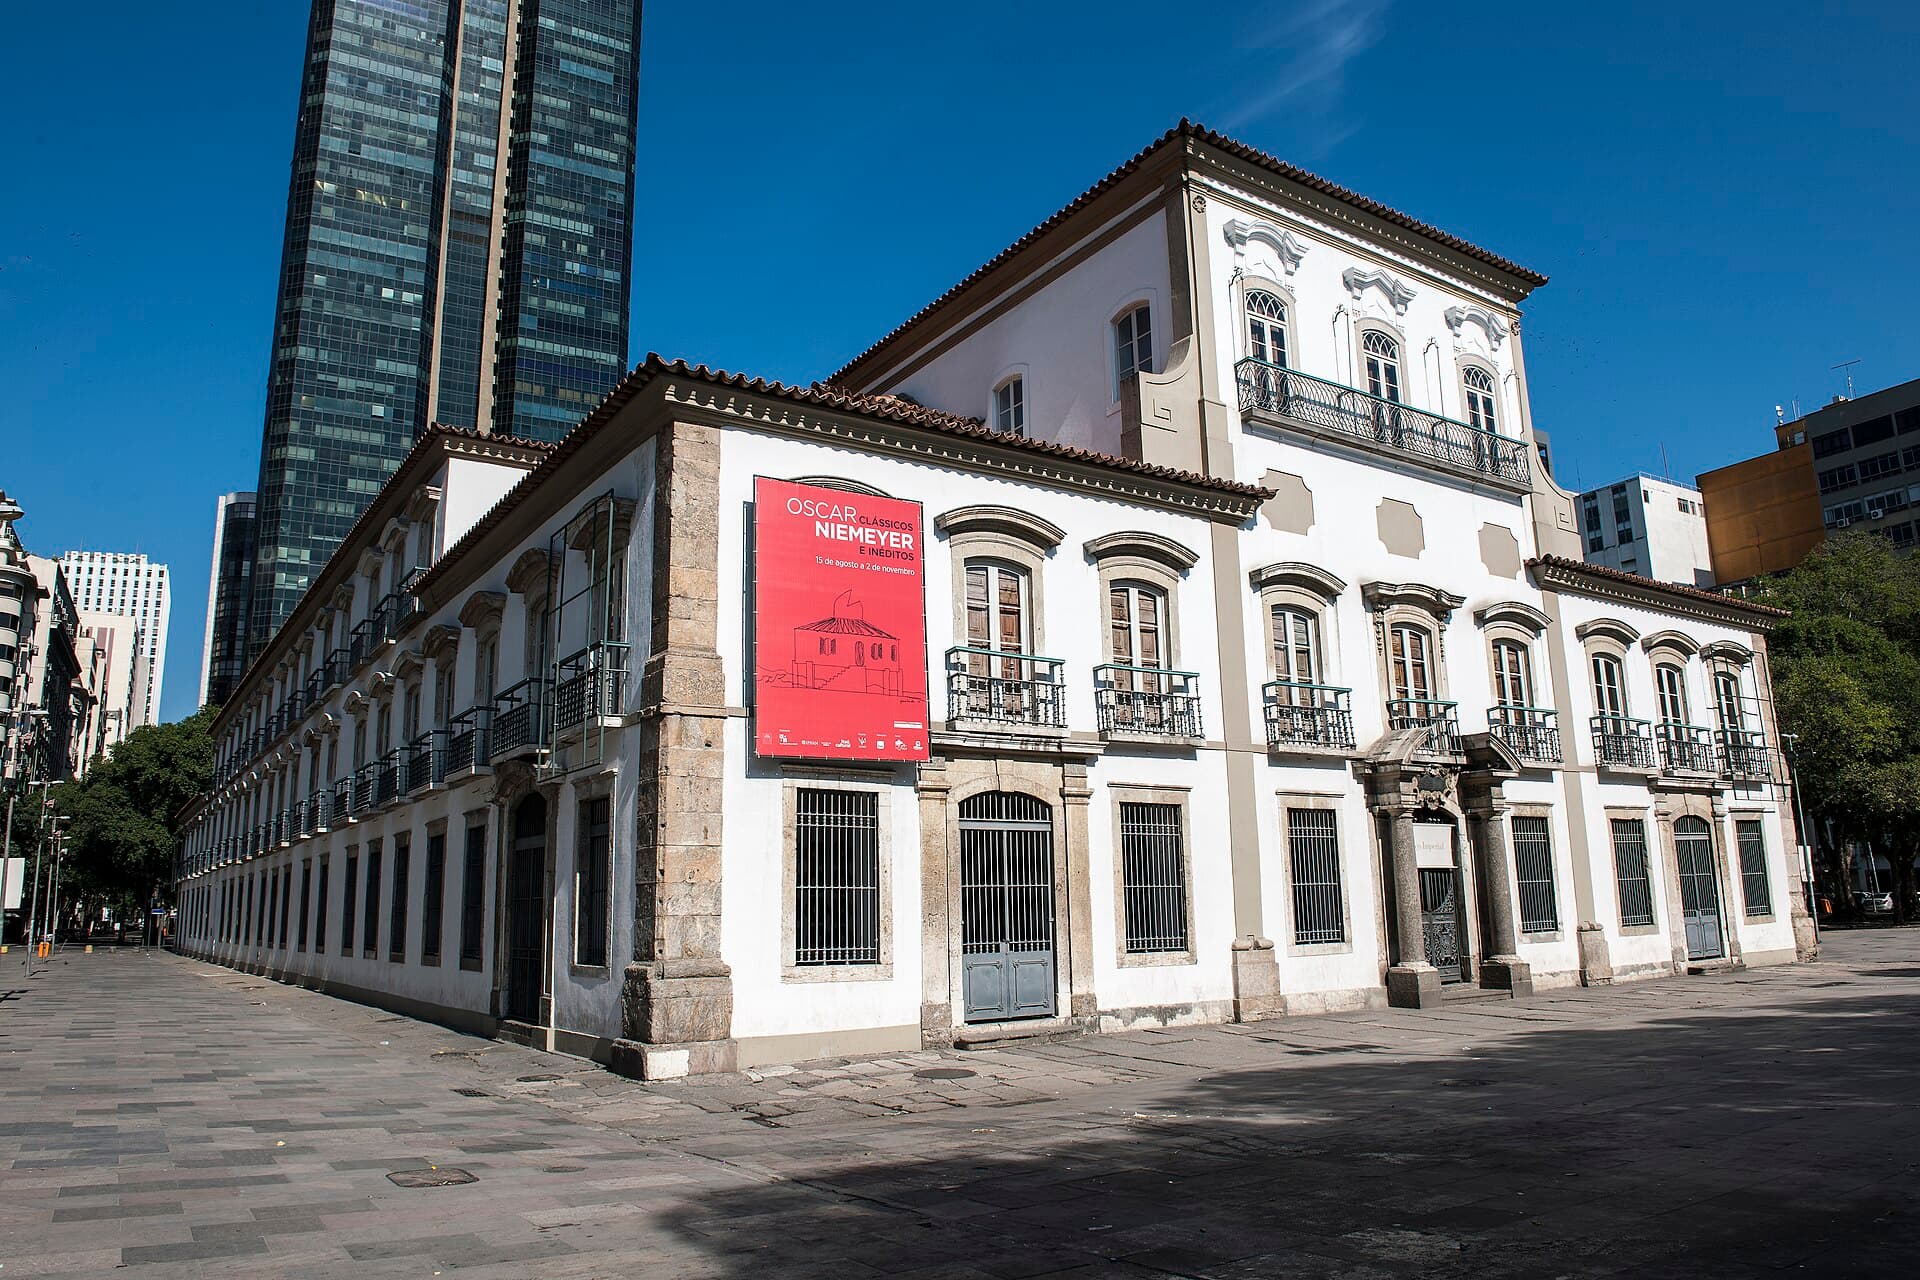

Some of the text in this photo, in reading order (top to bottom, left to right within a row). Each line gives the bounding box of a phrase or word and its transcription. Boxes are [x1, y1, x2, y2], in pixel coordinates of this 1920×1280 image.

[787, 497, 914, 532] OSCAR CLÁSSICOS
[815, 521, 914, 550] NIEMEYER
[859, 545, 915, 561] E INÉDITOS
[815, 556, 823, 565] 15
[824, 556, 834, 566] de
[835, 559, 858, 570] agosto
[866, 562, 871, 570] 2
[872, 563, 881, 572] de
[882, 564, 915, 576] novembro
